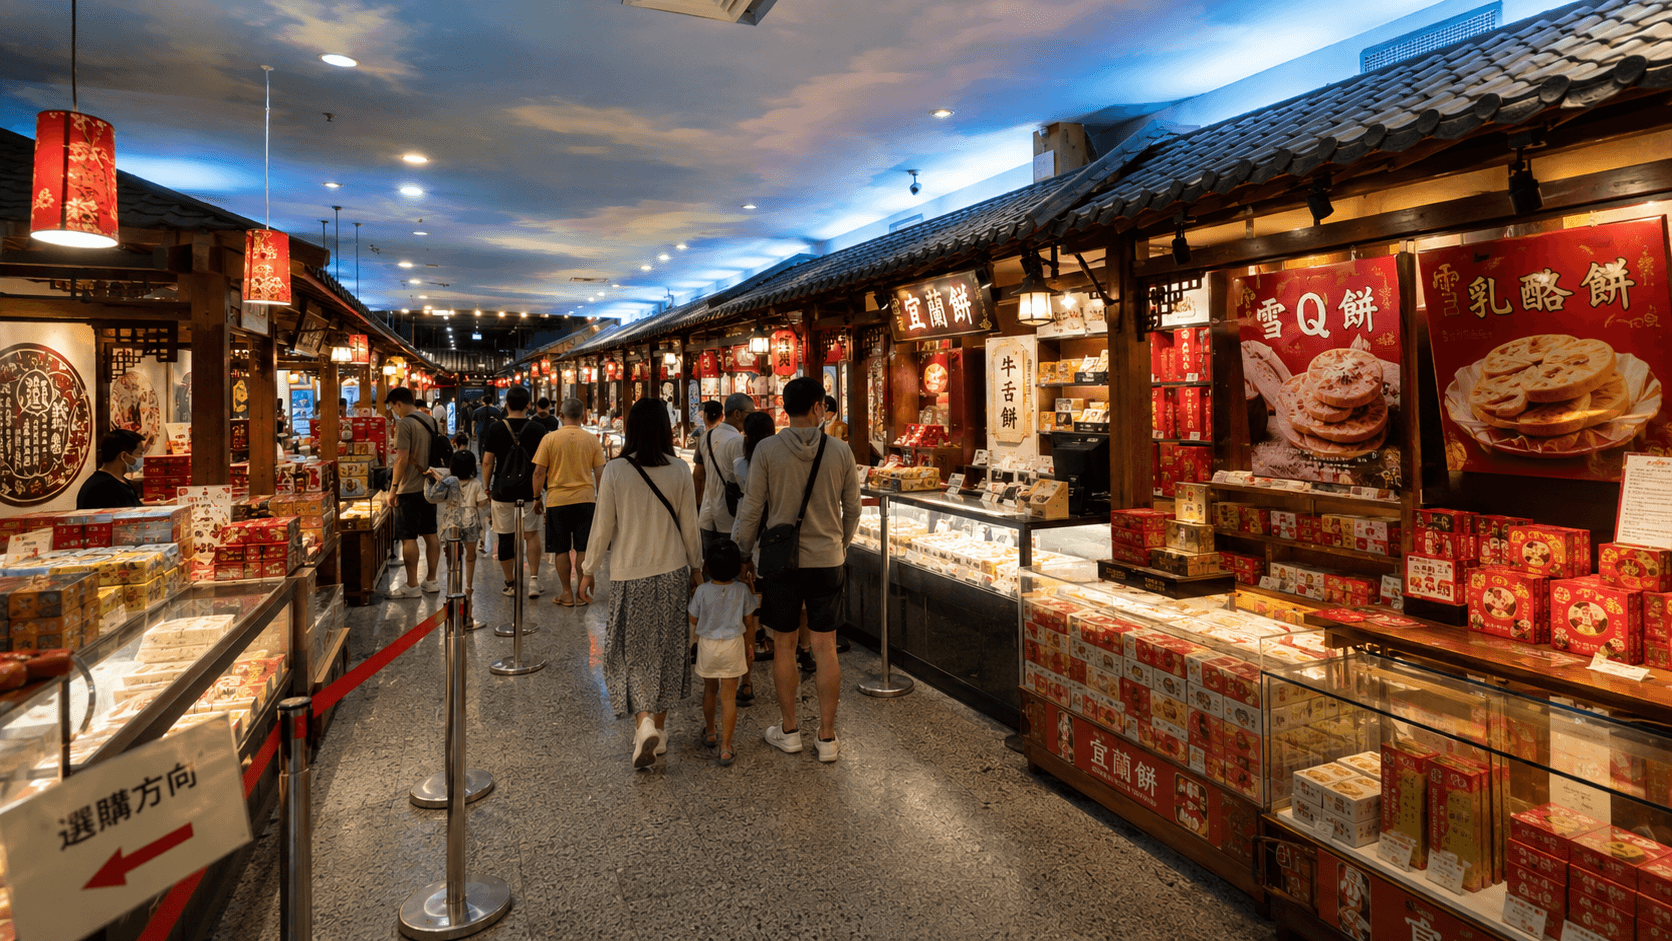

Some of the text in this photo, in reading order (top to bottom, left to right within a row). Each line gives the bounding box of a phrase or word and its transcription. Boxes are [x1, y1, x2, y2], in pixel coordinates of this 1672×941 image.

[904, 283, 973, 331] 宜蘭餅
[1256, 286, 1379, 340] 雪Q餅
[1468, 257, 1636, 319] 乳酪餅
[1000, 355, 1017, 430] 牛舌餅
[1090, 739, 1158, 797] 宜蘭餅
[57, 761, 197, 851] 選購方向
